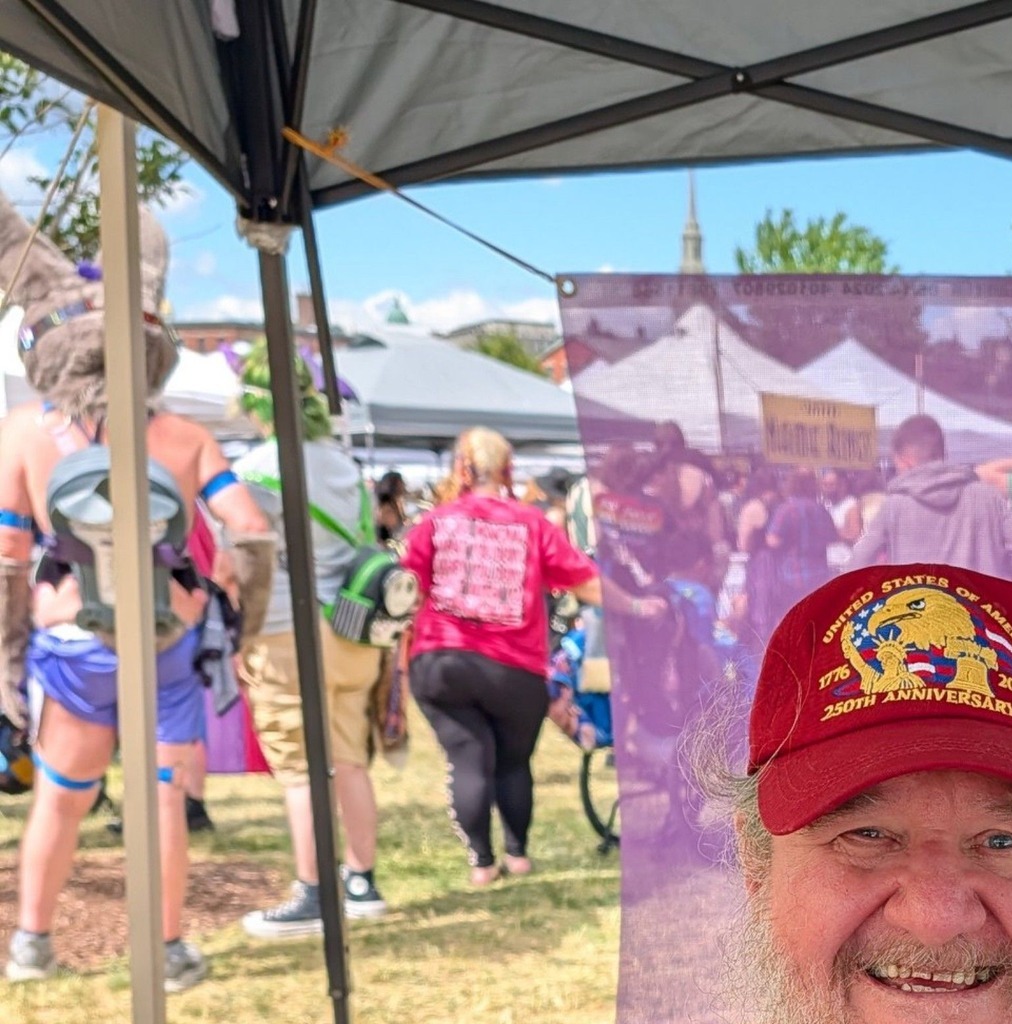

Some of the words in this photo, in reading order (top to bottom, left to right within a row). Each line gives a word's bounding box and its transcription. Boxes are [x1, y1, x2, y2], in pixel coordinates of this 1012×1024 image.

[823, 591, 874, 644] UNITED
[882, 575, 949, 593] STATES
[956, 587, 981, 603] OF
[818, 663, 850, 690] 1776
[820, 695, 876, 722] 250TH
